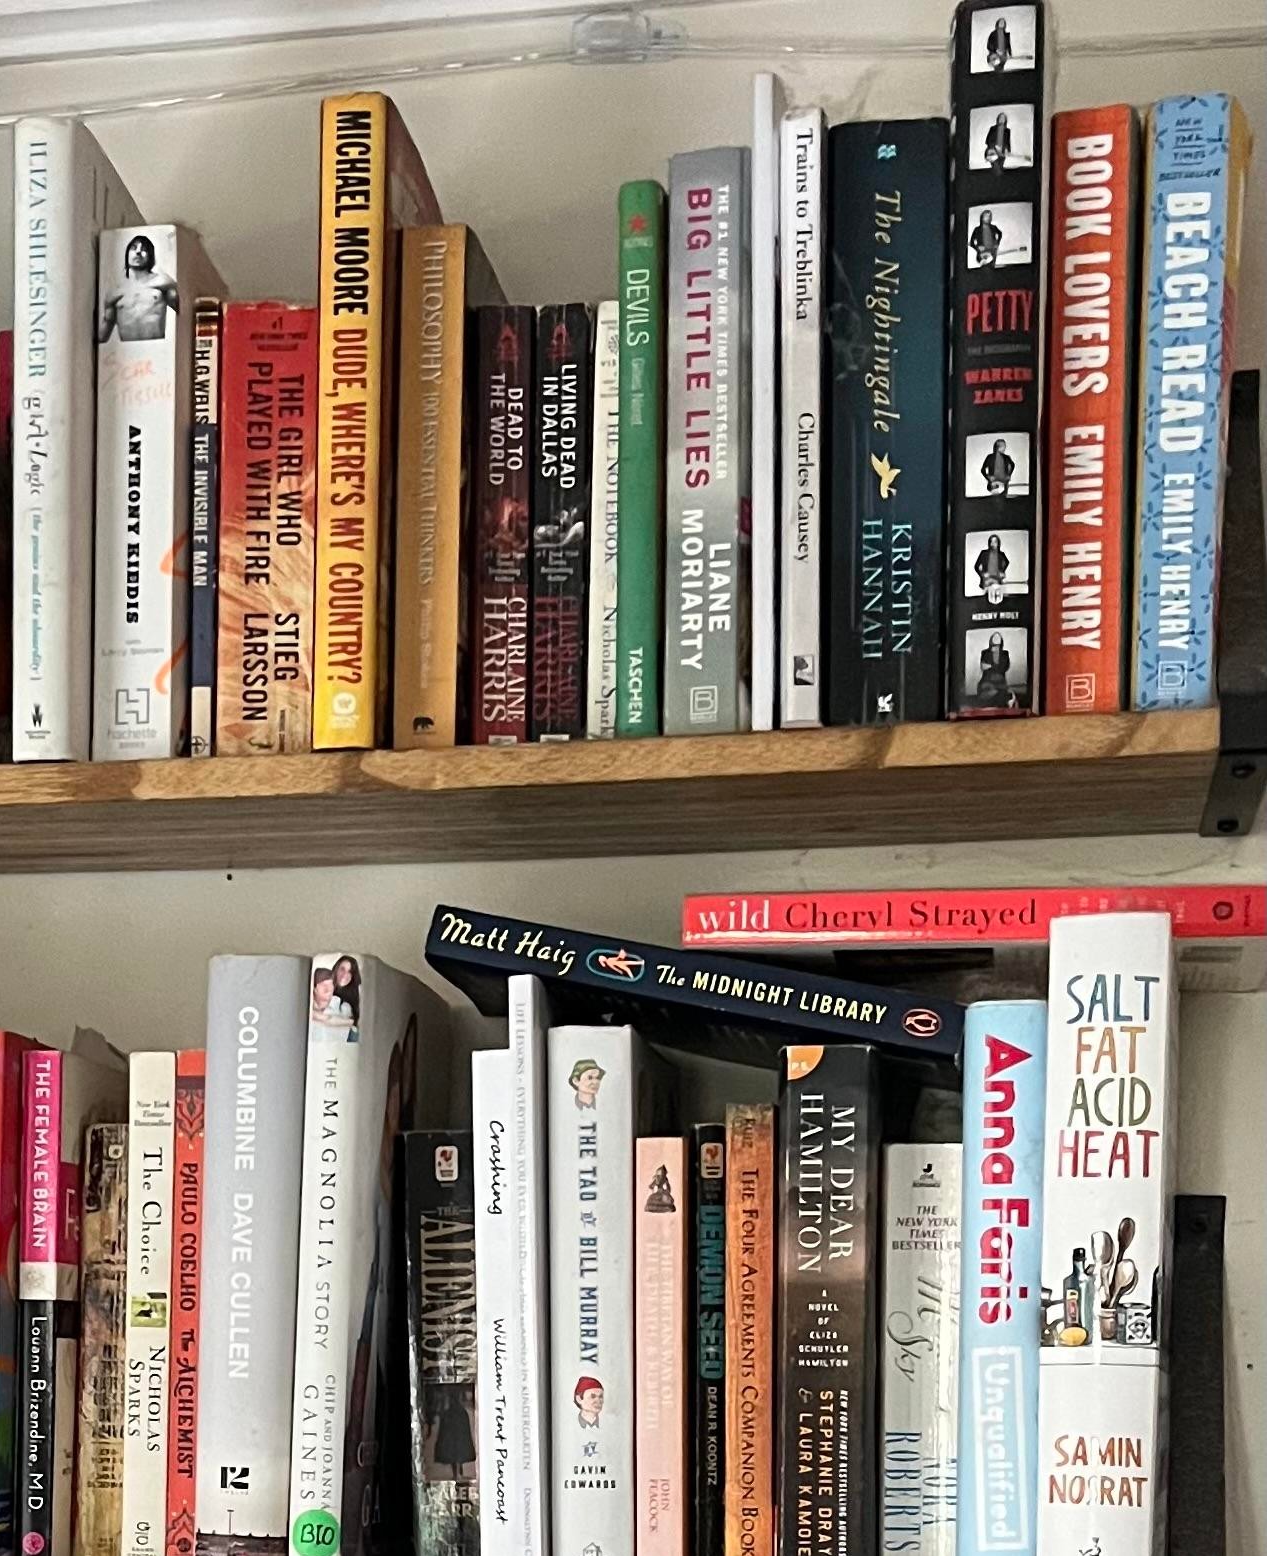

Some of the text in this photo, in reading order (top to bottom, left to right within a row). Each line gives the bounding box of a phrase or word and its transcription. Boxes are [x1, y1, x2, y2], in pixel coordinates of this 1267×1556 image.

[333, 110, 371, 315] MICHAEL MOORE
[795, 128, 814, 320] Trains to Treblinka
[1062, 133, 1114, 397] BOOK LOVERS
[625, 268, 650, 346] DEVILS
[684, 188, 712, 489] BIG LITTLE LIES
[966, 291, 1032, 335] PETTY
[1159, 190, 1212, 452] BEACH READ
[277, 374, 304, 418] THE
[277, 426, 303, 483] GIRL
[277, 490, 302, 546] WHO
[1061, 425, 1106, 650] EMILY HENRY
[679, 508, 704, 671] MORIARTY
[708, 543, 731, 633] LIANE
[1158, 473, 1194, 651] EMILY HENRY
[273, 612, 300, 681] STIEG
[628, 647, 644, 724] TASCHEN
[1066, 975, 1160, 1025] SALT
[1075, 1026, 1146, 1074] FAT
[1067, 1078, 1152, 1128] ACID
[32, 1061, 50, 1247] THE FEMALE BRAIN
[229, 1007, 259, 1378] COLUMBINE DAVE CULLEN
[487, 1121, 504, 1214] Crashing
[977, 1034, 1032, 1325] Anna Faris
[1057, 1130, 1159, 1179] HEAT
[493, 1319, 508, 1524] William Trent Pancoast
[708, 1387, 718, 1418] DEAN
[564, 1480, 617, 1491] EDWARDS
[573, 1465, 607, 1476] GAVIN
[707, 1436, 718, 1486] KOONTZ
[301, 1527, 335, 1546] BIO
